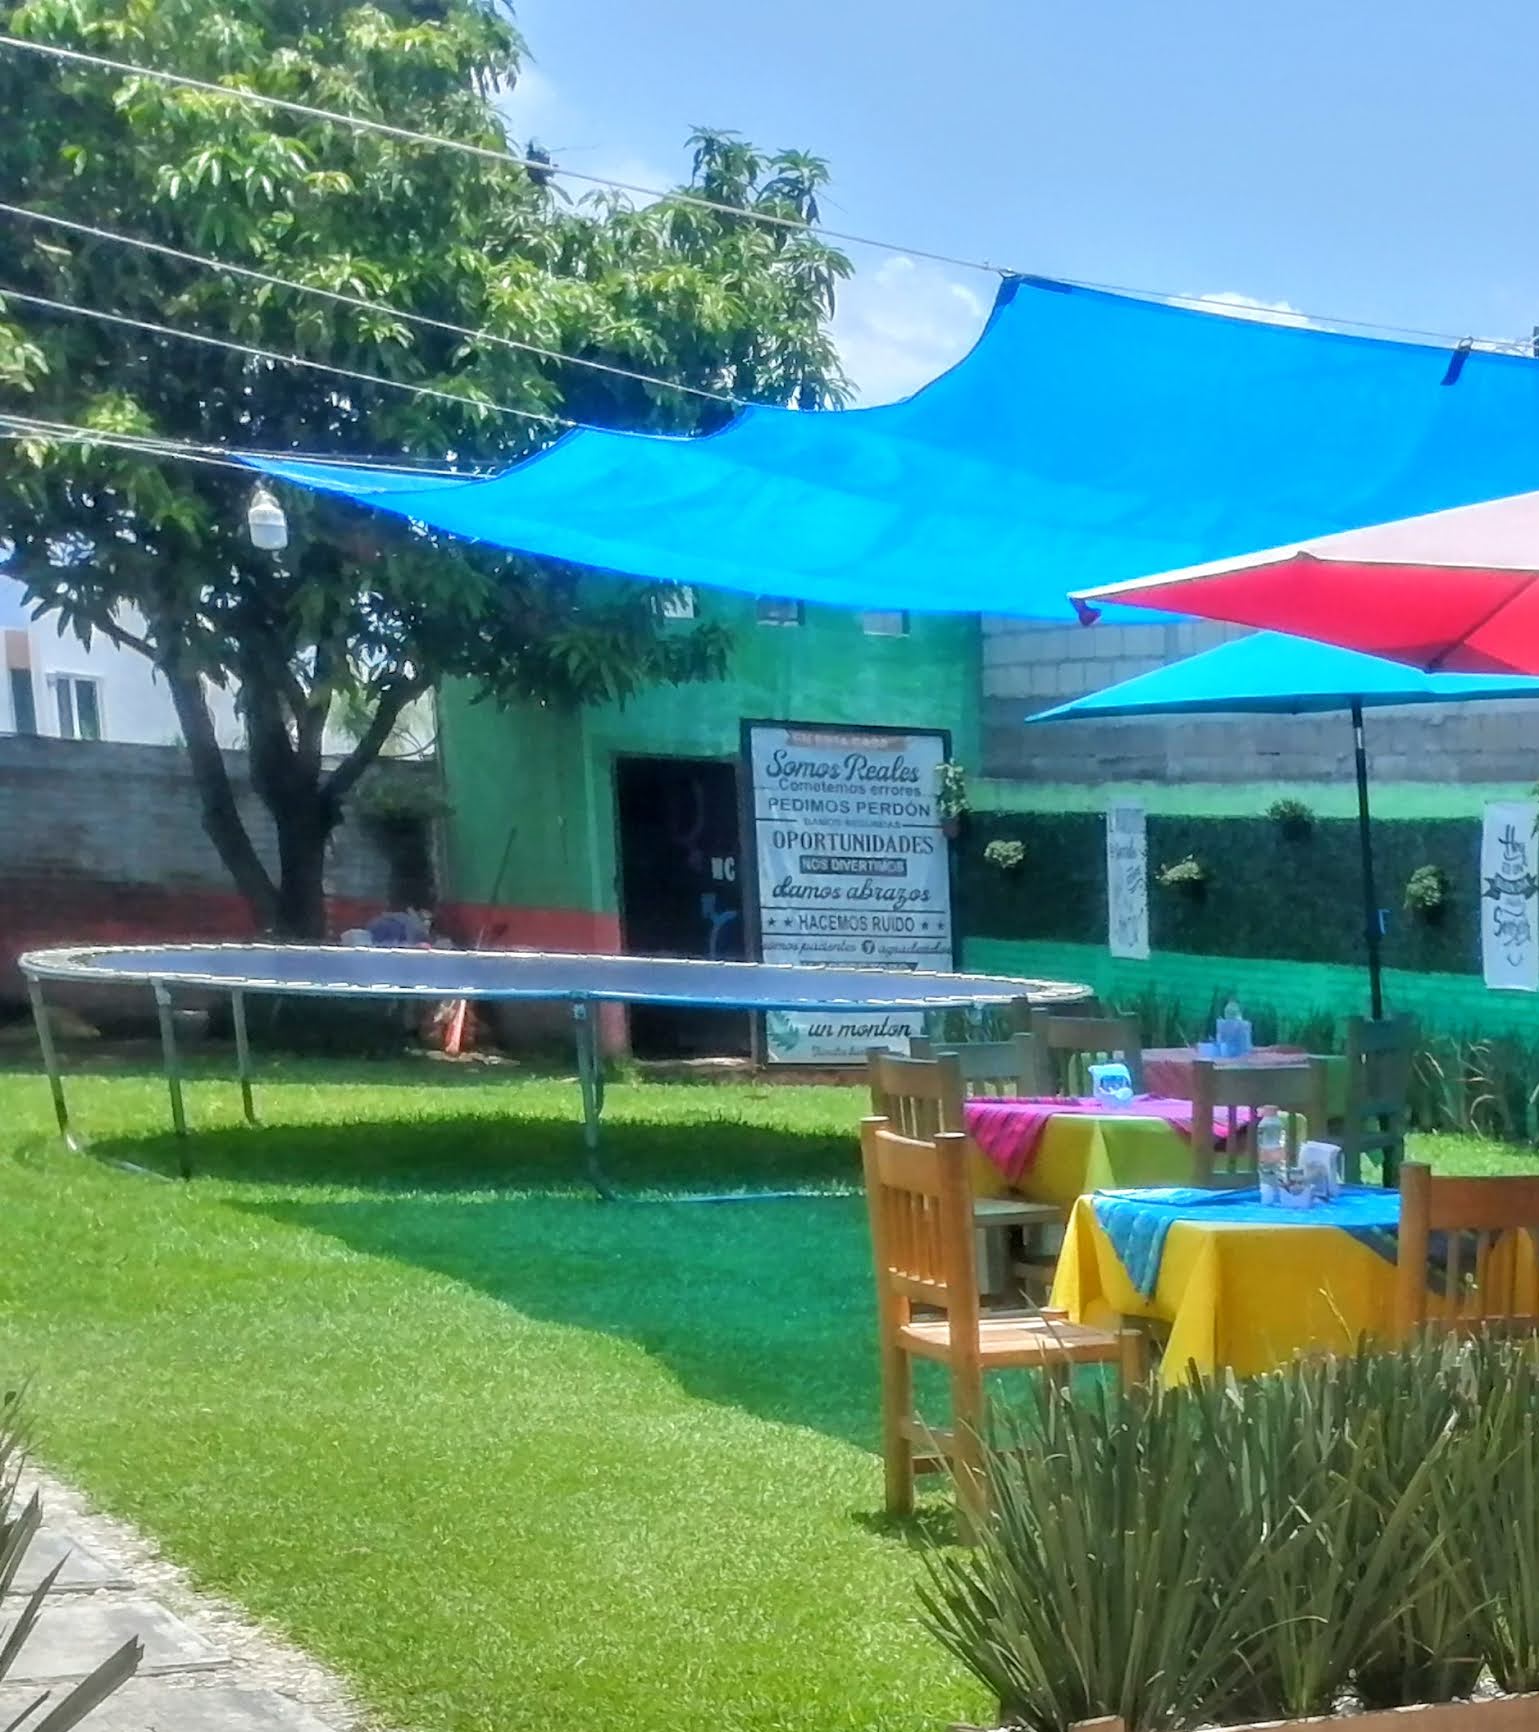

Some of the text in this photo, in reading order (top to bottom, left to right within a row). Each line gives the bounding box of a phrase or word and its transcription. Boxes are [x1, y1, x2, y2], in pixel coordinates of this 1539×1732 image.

[766, 749, 920, 783] Somos Reales
[778, 778, 921, 798] Cometemos errores
[768, 797, 931, 818] PEDIMOS PERDÓN
[772, 830, 934, 855] OPORTUNIDADES
[803, 858, 905, 874] NOS DIVERTIMOS
[772, 875, 931, 911] damos abrazos
[800, 915, 915, 933] HACEMOS RUIDO
[808, 1023, 831, 1037] un
